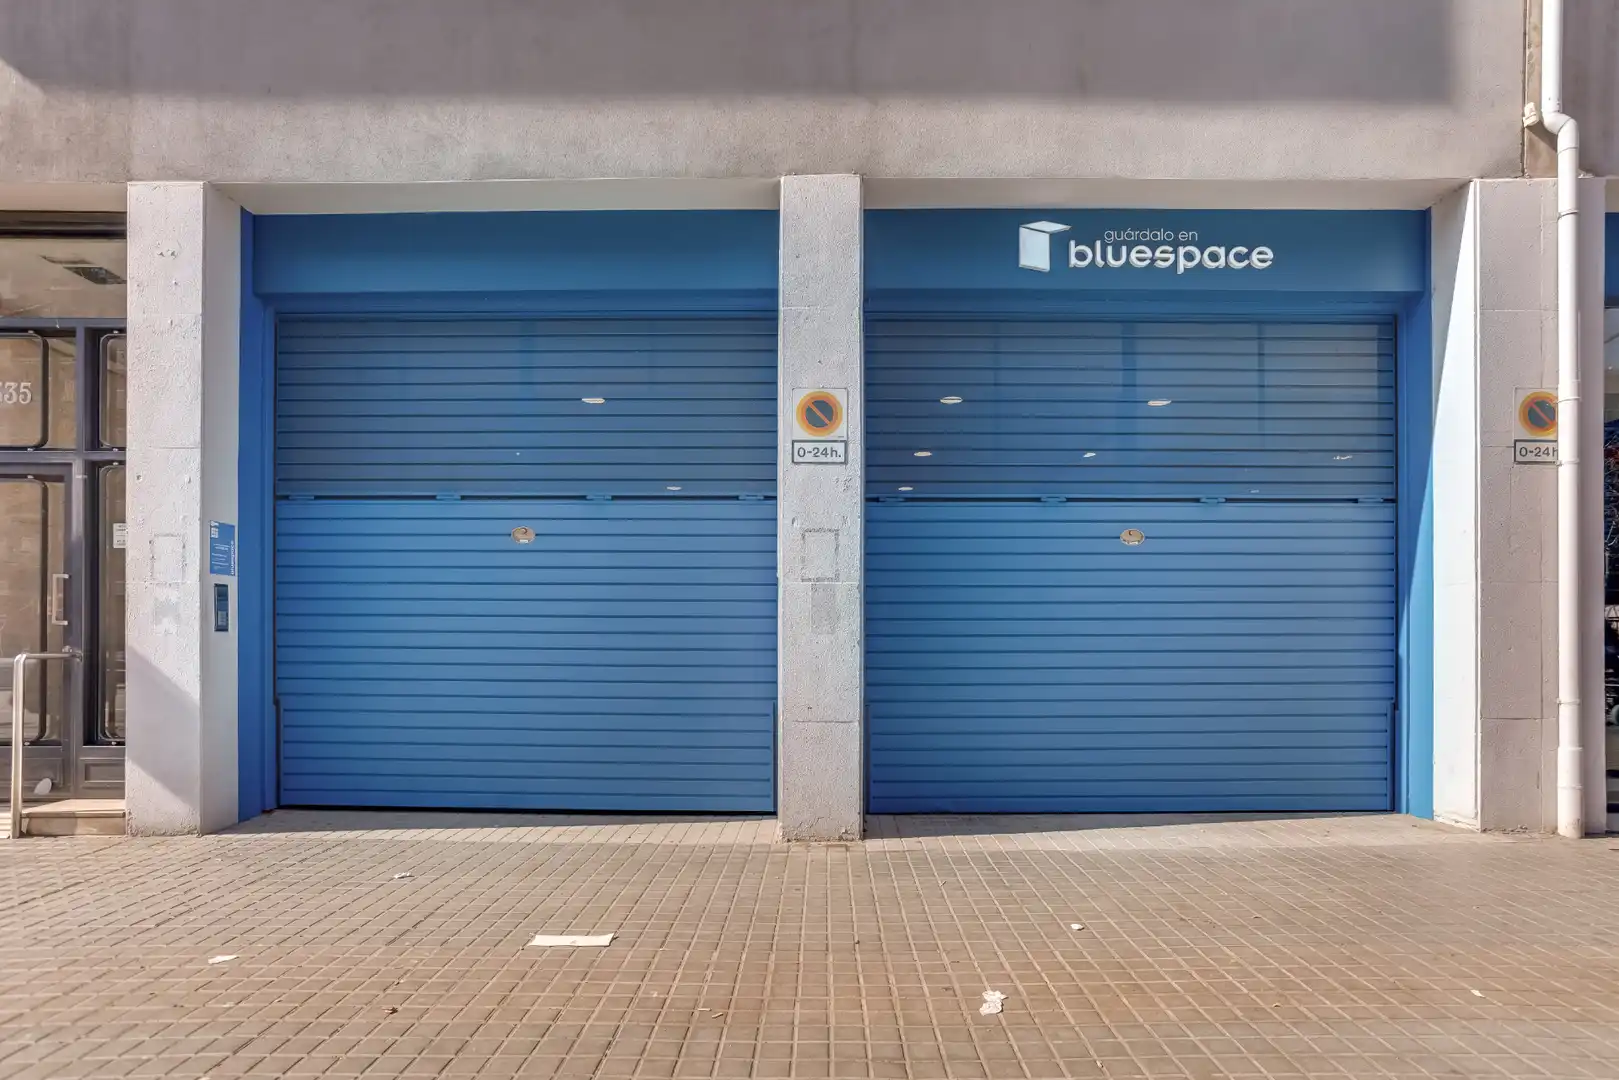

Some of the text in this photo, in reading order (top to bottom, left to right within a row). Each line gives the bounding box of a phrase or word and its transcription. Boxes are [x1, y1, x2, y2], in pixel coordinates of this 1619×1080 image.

[1104, 228, 1198, 243] guárdalo en
[1069, 240, 1274, 274] bluespace
[0, 382, 31, 404] 35
